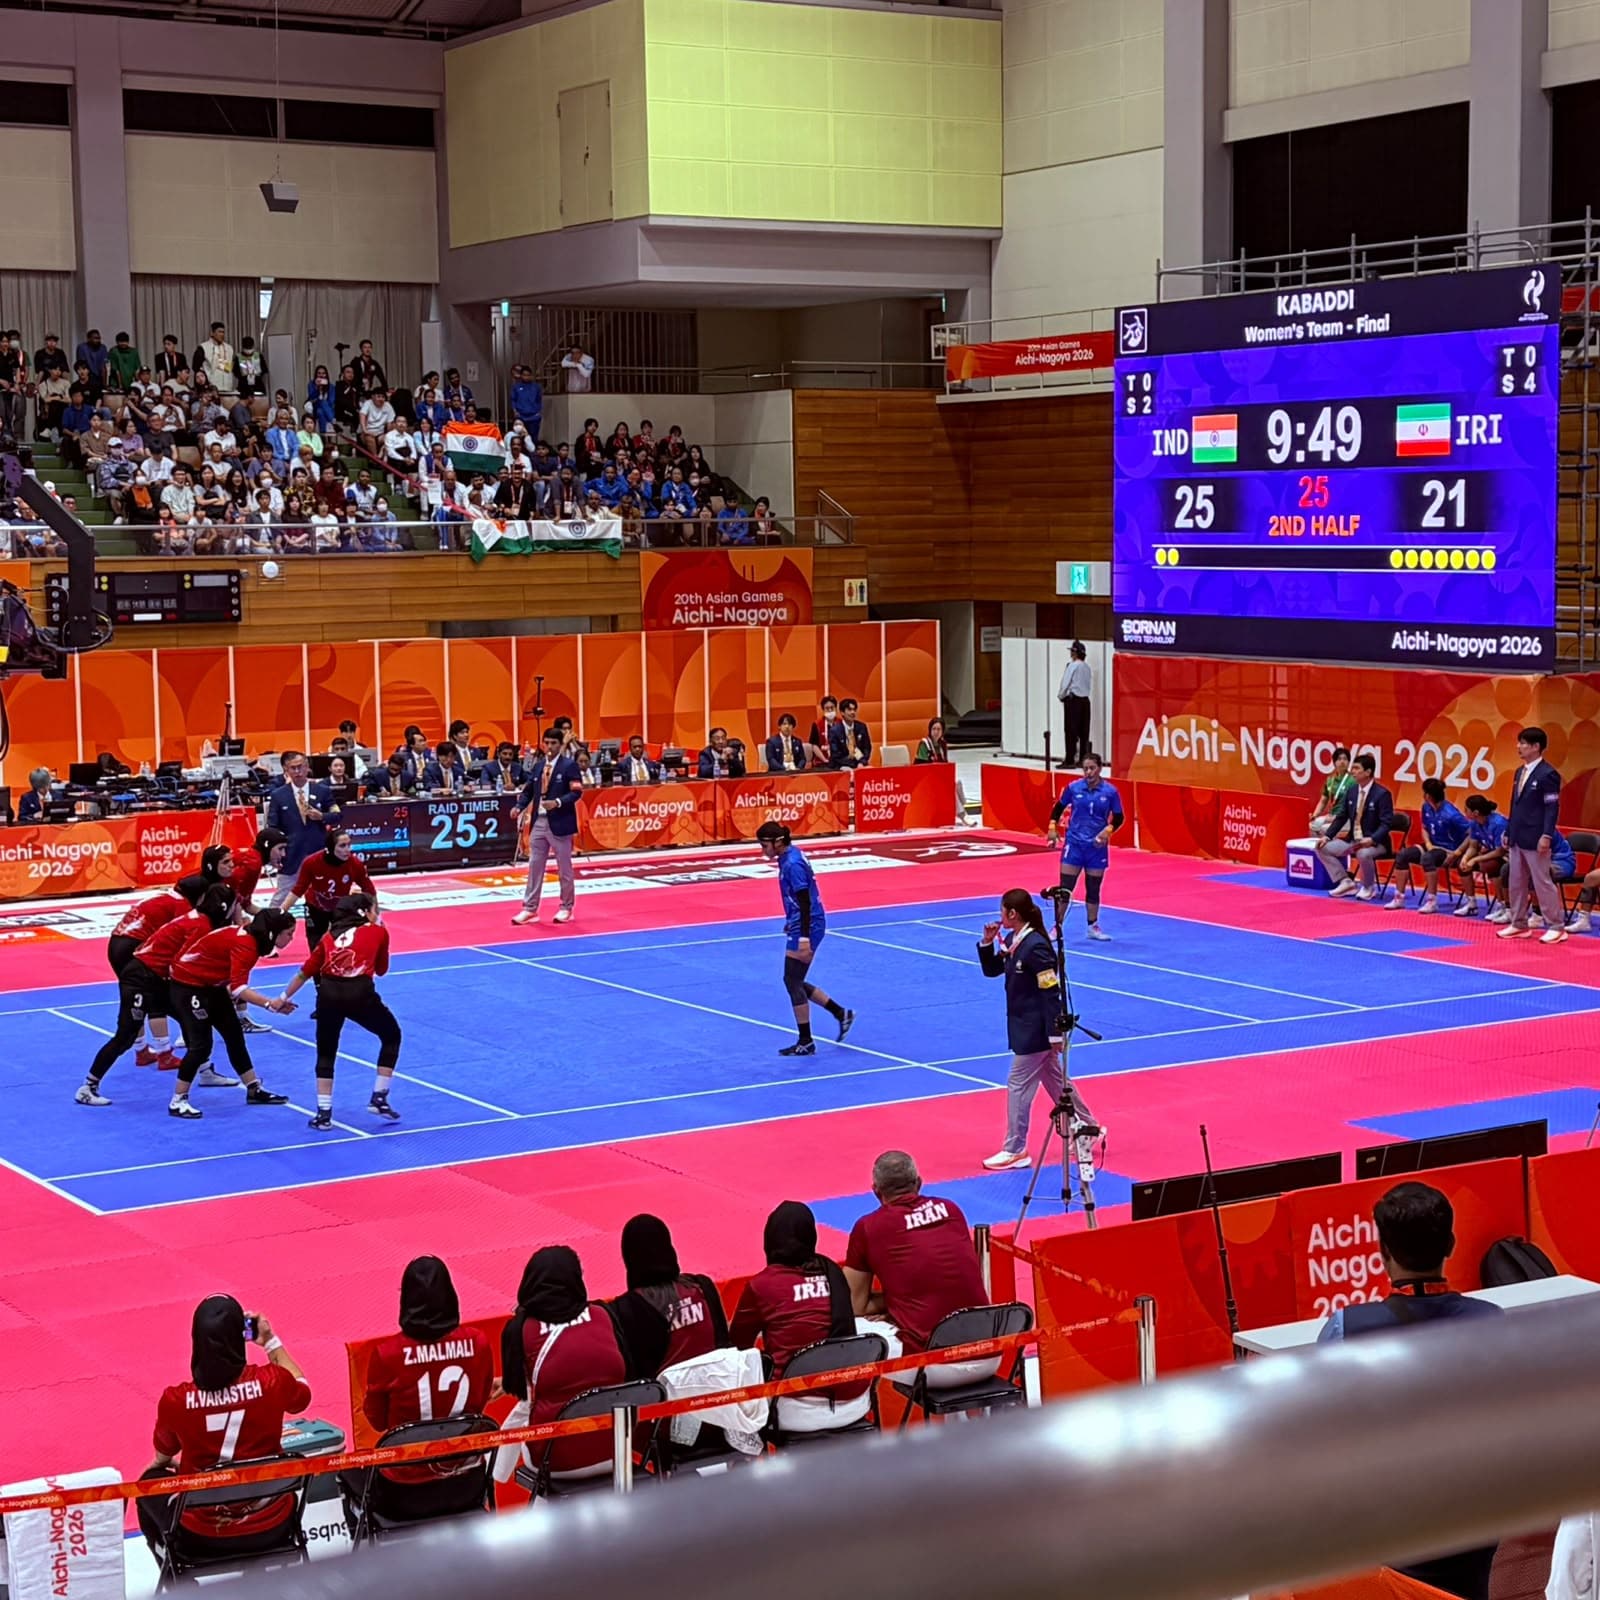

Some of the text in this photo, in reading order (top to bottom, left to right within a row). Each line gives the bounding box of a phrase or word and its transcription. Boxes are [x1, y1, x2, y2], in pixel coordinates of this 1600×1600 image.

[1277, 289, 1355, 316] KABADDI
[1245, 324, 1304, 343] Women's
[1306, 320, 1344, 337] Team
[1356, 313, 1390, 334] Final
[1016, 348, 1094, 366] Aichi-Nagoya 2026
[1503, 346, 1536, 367] T 0
[1126, 373, 1152, 391] T 0
[1502, 372, 1536, 394] S 4
[1126, 396, 1152, 415] S 2
[1267, 406, 1362, 464] 9:49
[1456, 414, 1503, 446] IRI
[1152, 429, 1189, 456] IND
[1299, 476, 1329, 508] 25
[1174, 485, 1215, 529] 25
[1422, 479, 1466, 528] 21
[1269, 515, 1360, 536] 2ND HALF
[674, 592, 784, 605] 20th Asian Games
[673, 606, 787, 626] Aichi-Nagoya
[1122, 619, 1176, 636] BORNAN
[1391, 630, 1542, 658] Aichi-Nagoya 2026
[1393, 739, 1495, 790] 2026
[863, 778, 900, 793] Aichi-
[428, 800, 500, 815] RAID TIMER
[735, 790, 829, 808] Aichi-Nagoya
[862, 792, 911, 808] Nagoya
[394, 806, 408, 818] 25
[594, 800, 694, 818] Aichi-Nagoya
[764, 807, 799, 823] 2026
[863, 807, 894, 821] 2026
[1224, 804, 1256, 820] Aichi-
[141, 825, 188, 842] Aichi-
[394, 827, 408, 840] 21
[431, 813, 498, 849] 25.2
[626, 818, 662, 832] 2026
[1223, 819, 1266, 838] Nagoya
[0, 842, 112, 861] ichi-Nagoya
[141, 842, 201, 859] Nagoya
[1223, 836, 1250, 851] 2026
[28, 861, 74, 878] 2026
[143, 859, 182, 875] 2026
[328, 879, 336, 893] 2
[134, 993, 143, 1007] 3
[191, 995, 200, 1008] 6
[904, 1202, 949, 1230] IRAN
[793, 1282, 830, 1301] IRA
[403, 1338, 475, 1366] Z.MALMALI
[186, 1380, 263, 1409] H.VARASTEH
[417, 1365, 470, 1420] 12
[205, 1409, 246, 1463] 7
[68, 1509, 88, 1557] 2026
